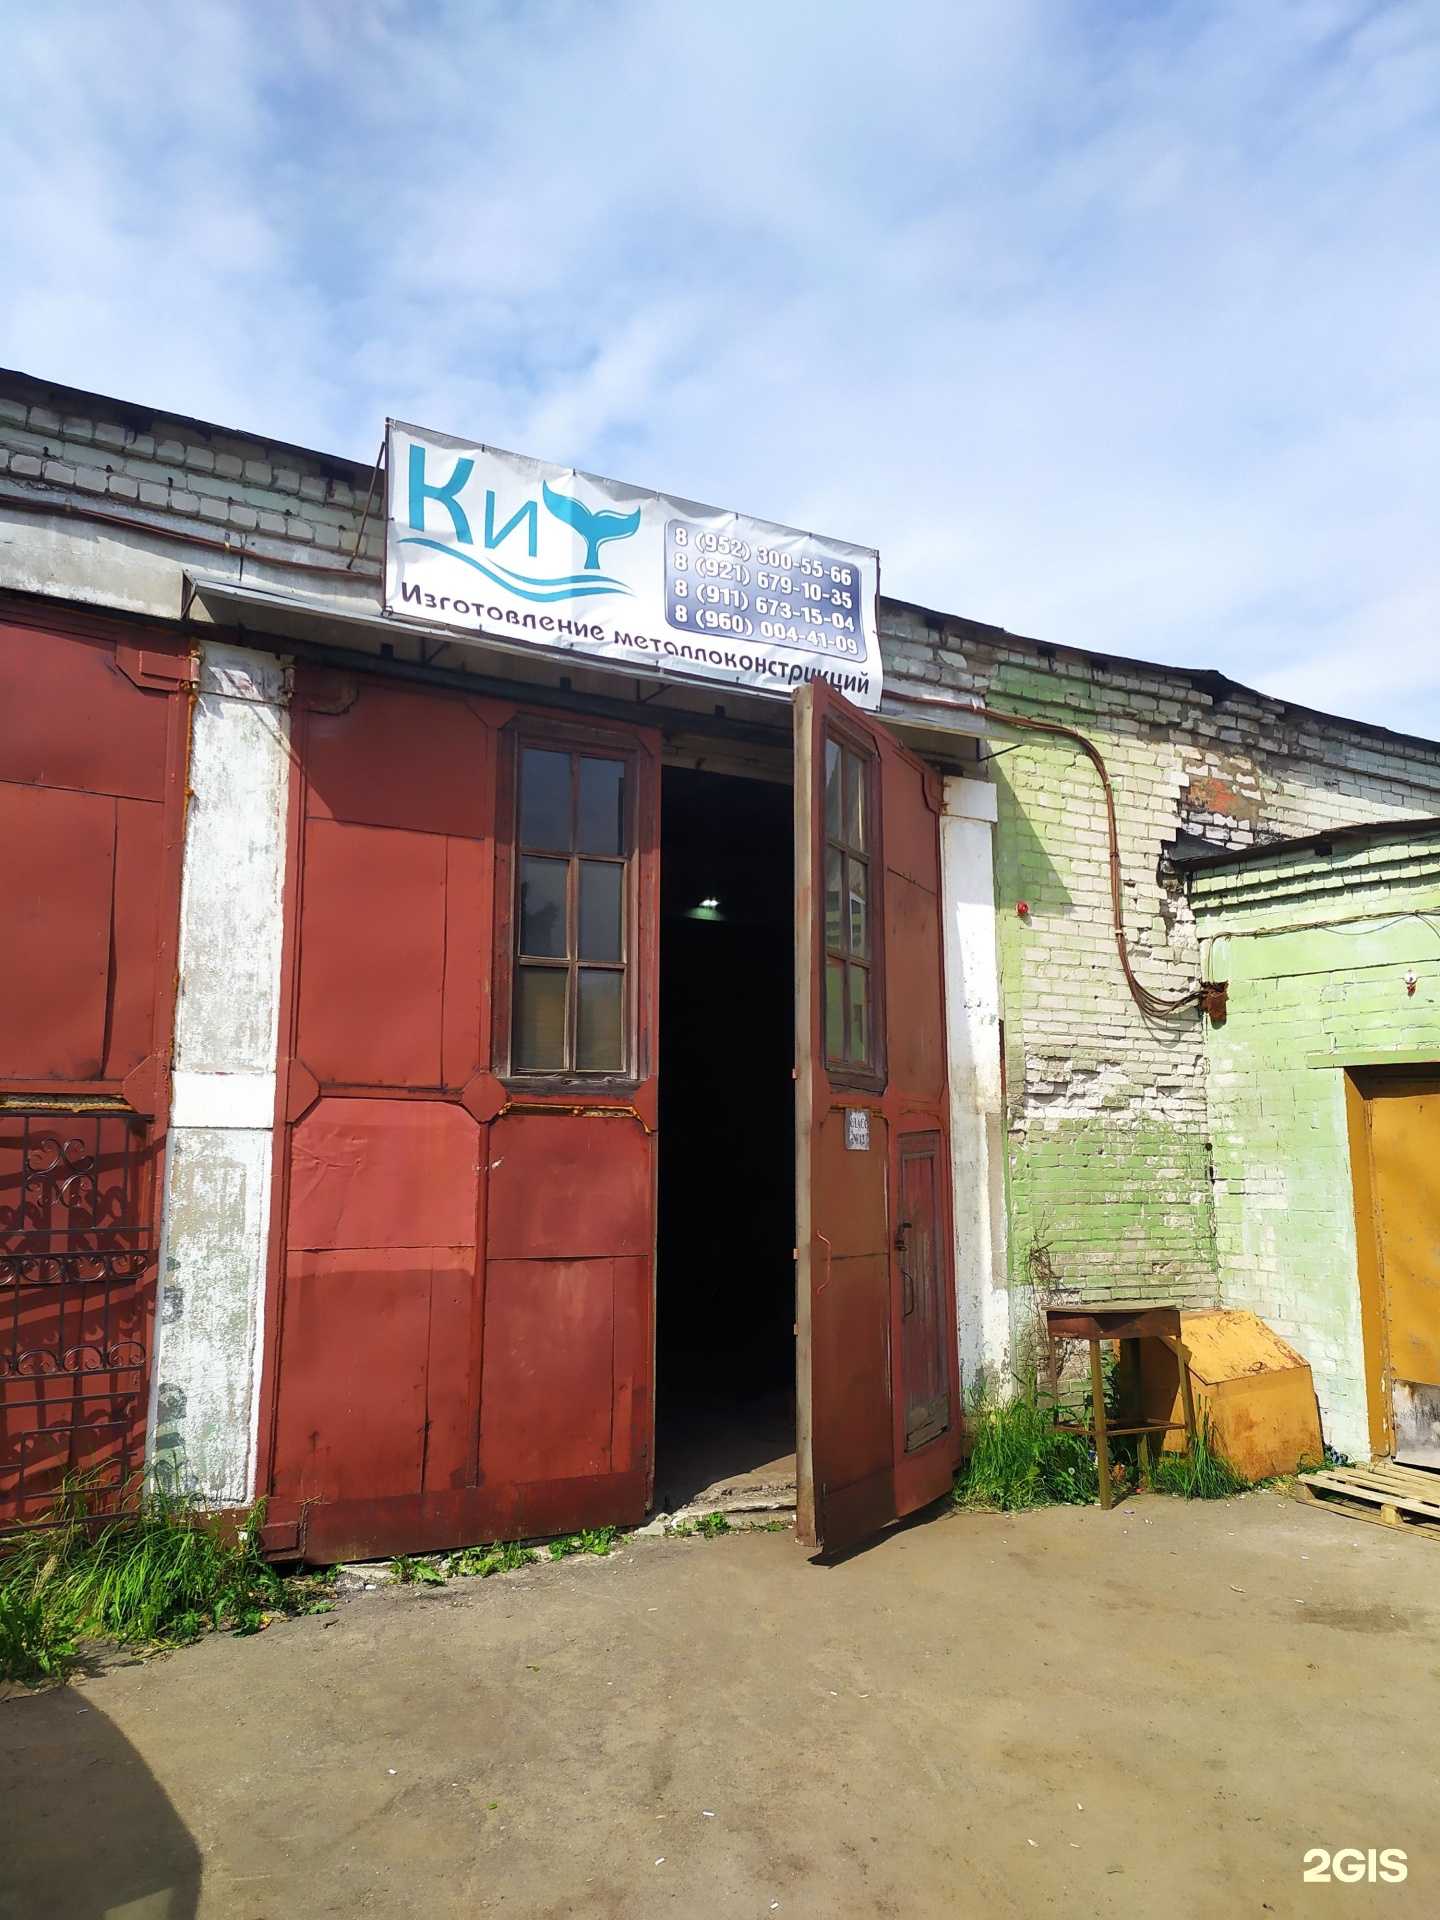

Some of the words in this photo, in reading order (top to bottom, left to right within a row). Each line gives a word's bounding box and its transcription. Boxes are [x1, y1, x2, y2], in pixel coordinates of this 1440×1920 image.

[674, 527, 689, 546] 8
[695, 532, 751, 562] (952)
[757, 545, 852, 586] 300-55-66
[674, 552, 688, 571] 8
[695, 558, 750, 586] (921)
[757, 571, 853, 609] 679-10-35
[401, 581, 605, 641] Изготовление
[674, 579, 688, 598] 8
[695, 583, 750, 611] (911)
[755, 596, 855, 633] 673-15-04
[674, 604, 688, 623] 8
[695, 608, 753, 636] (960)
[760, 621, 858, 655] 004-41-09
